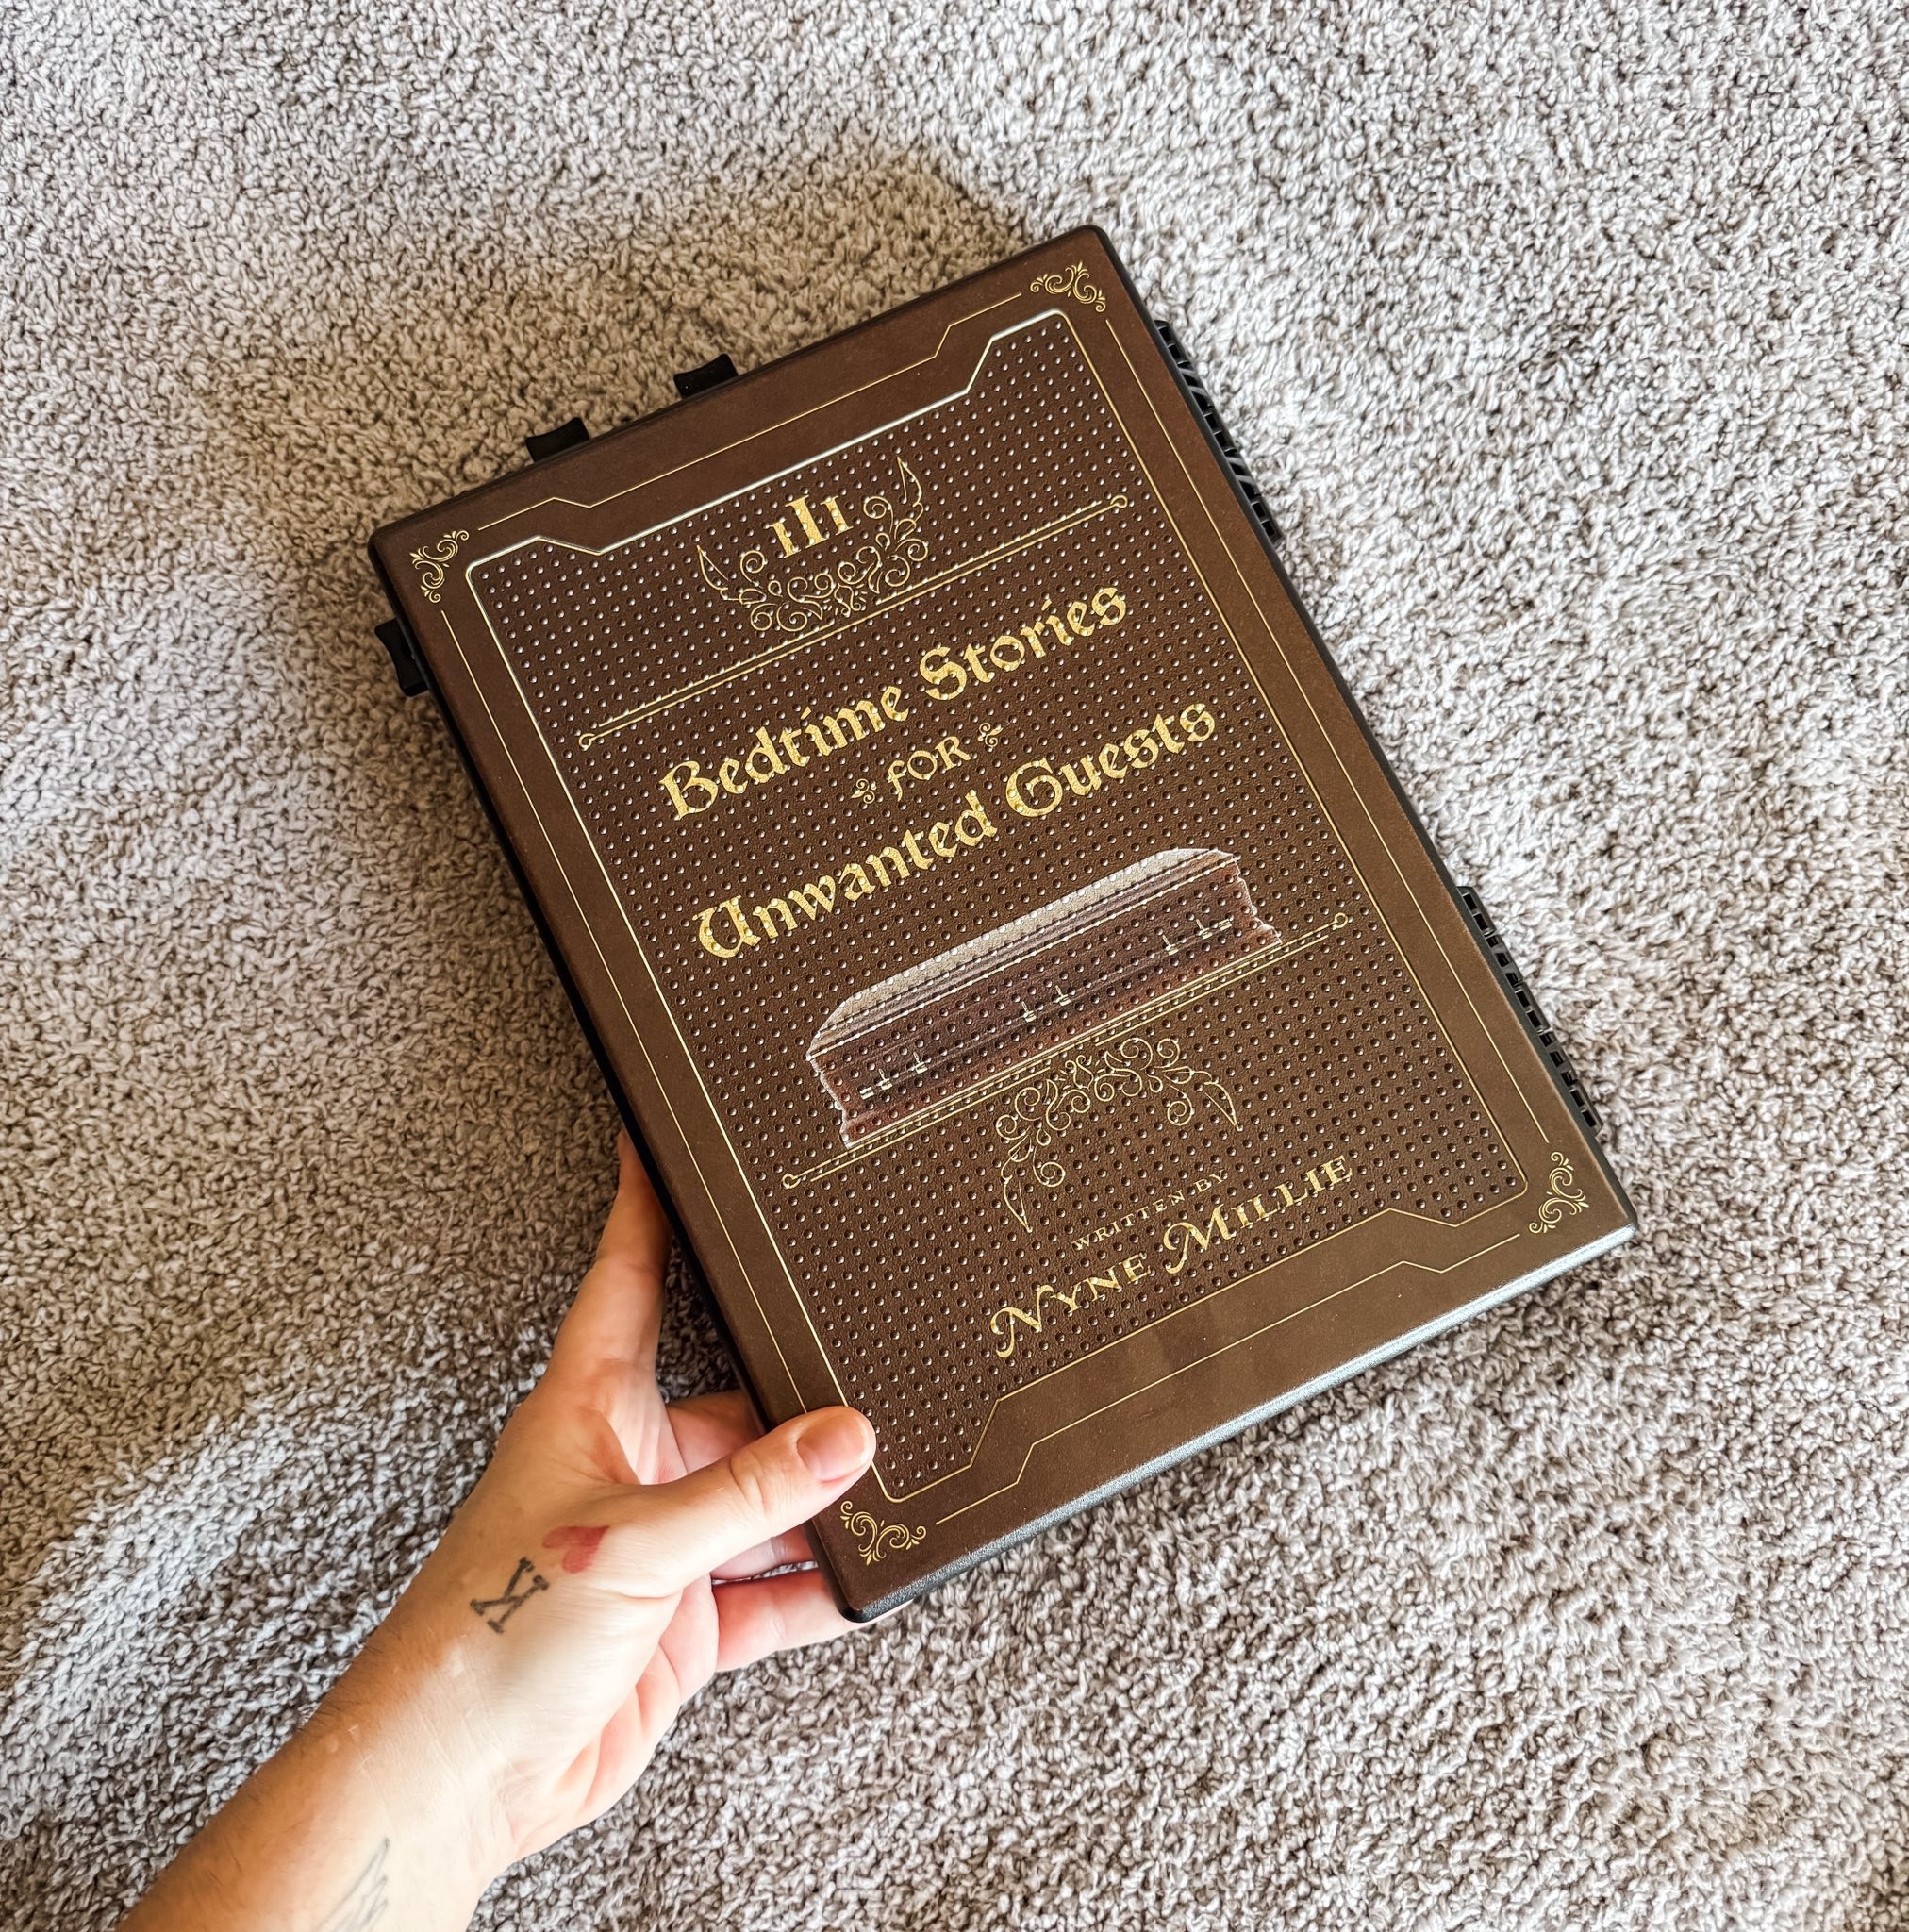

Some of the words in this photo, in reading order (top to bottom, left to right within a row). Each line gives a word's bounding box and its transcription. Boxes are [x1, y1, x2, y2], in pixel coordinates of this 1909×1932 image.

[658, 685, 910, 821] Bedtime
[919, 585, 1128, 701] Stories
[692, 790, 999, 959] Unwanted
[1005, 701, 1218, 818] Guests
[990, 1253, 1153, 1359] NYNE
[1163, 1155, 1353, 1274] MILLIE
[1071, 1189, 1187, 1251] WRITTEN
[1194, 1169, 1228, 1193] BY
[469, 1557, 550, 1634] K
